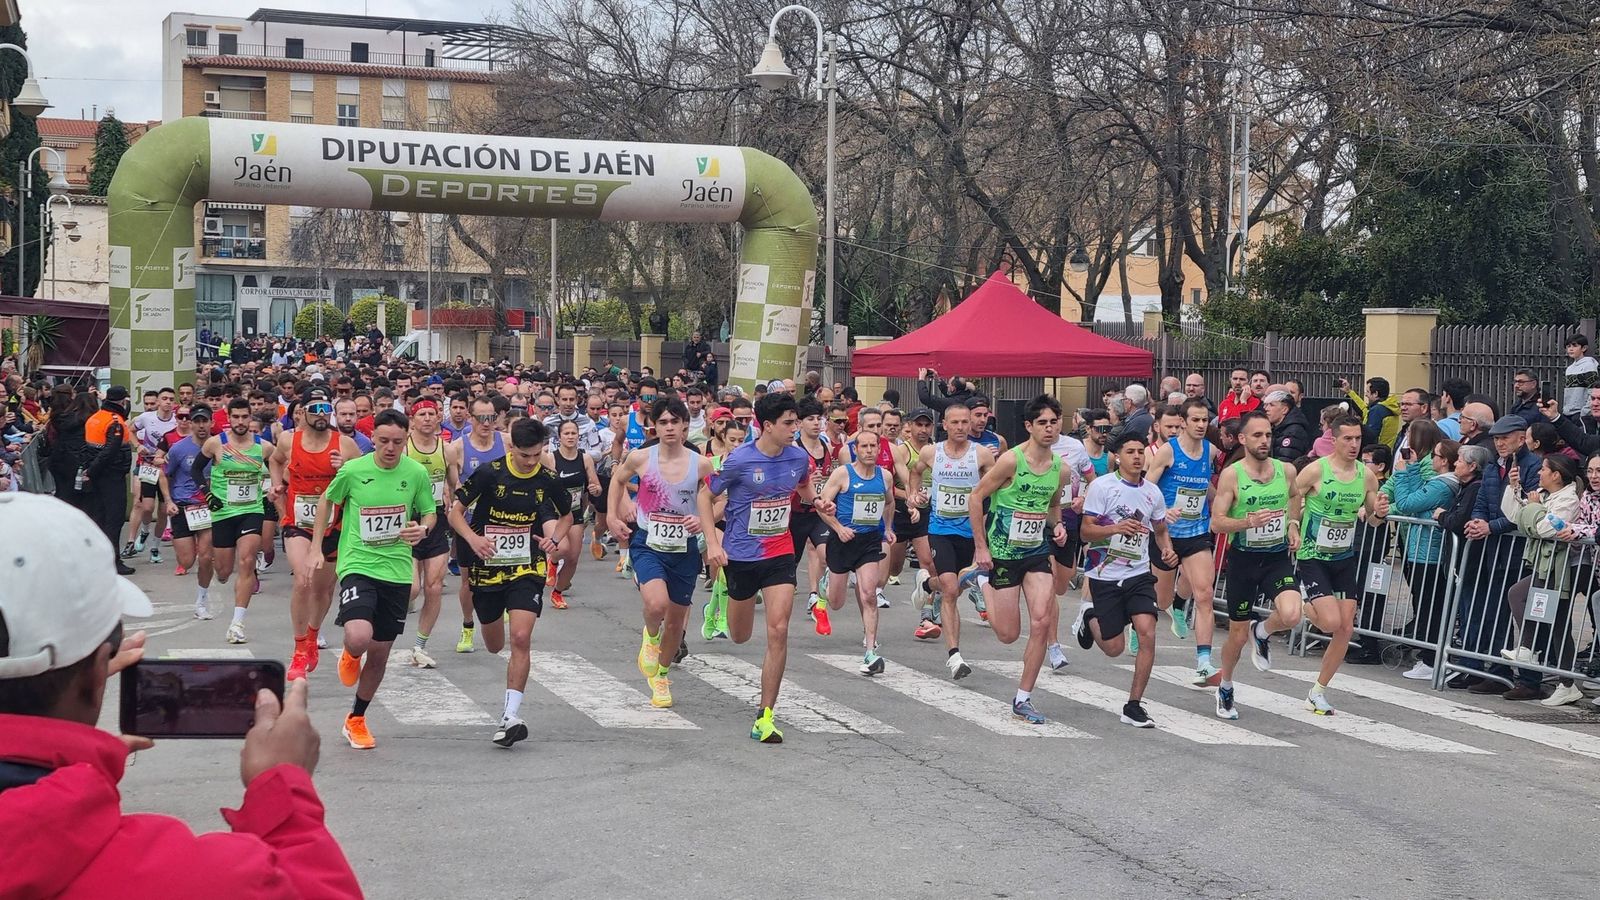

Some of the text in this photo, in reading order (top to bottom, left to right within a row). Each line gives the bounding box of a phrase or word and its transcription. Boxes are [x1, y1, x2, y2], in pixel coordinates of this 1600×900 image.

[322, 138, 655, 176] DIPUTACIÓN DE JAÉN
[234, 156, 292, 182] Jaén
[381, 174, 598, 205] DEPORTES
[681, 180, 732, 202] Jaén
[238, 486, 250, 496] 58
[944, 493, 965, 505] 216
[1186, 497, 1199, 508] 53
[489, 506, 529, 521] helvetia
[757, 507, 787, 522] 1327
[864, 502, 877, 513] 48
[366, 515, 402, 532] 1274
[654, 523, 683, 538] 1323
[1017, 520, 1042, 534] 1298
[1327, 529, 1348, 541] 698
[342, 586, 360, 604] 21
